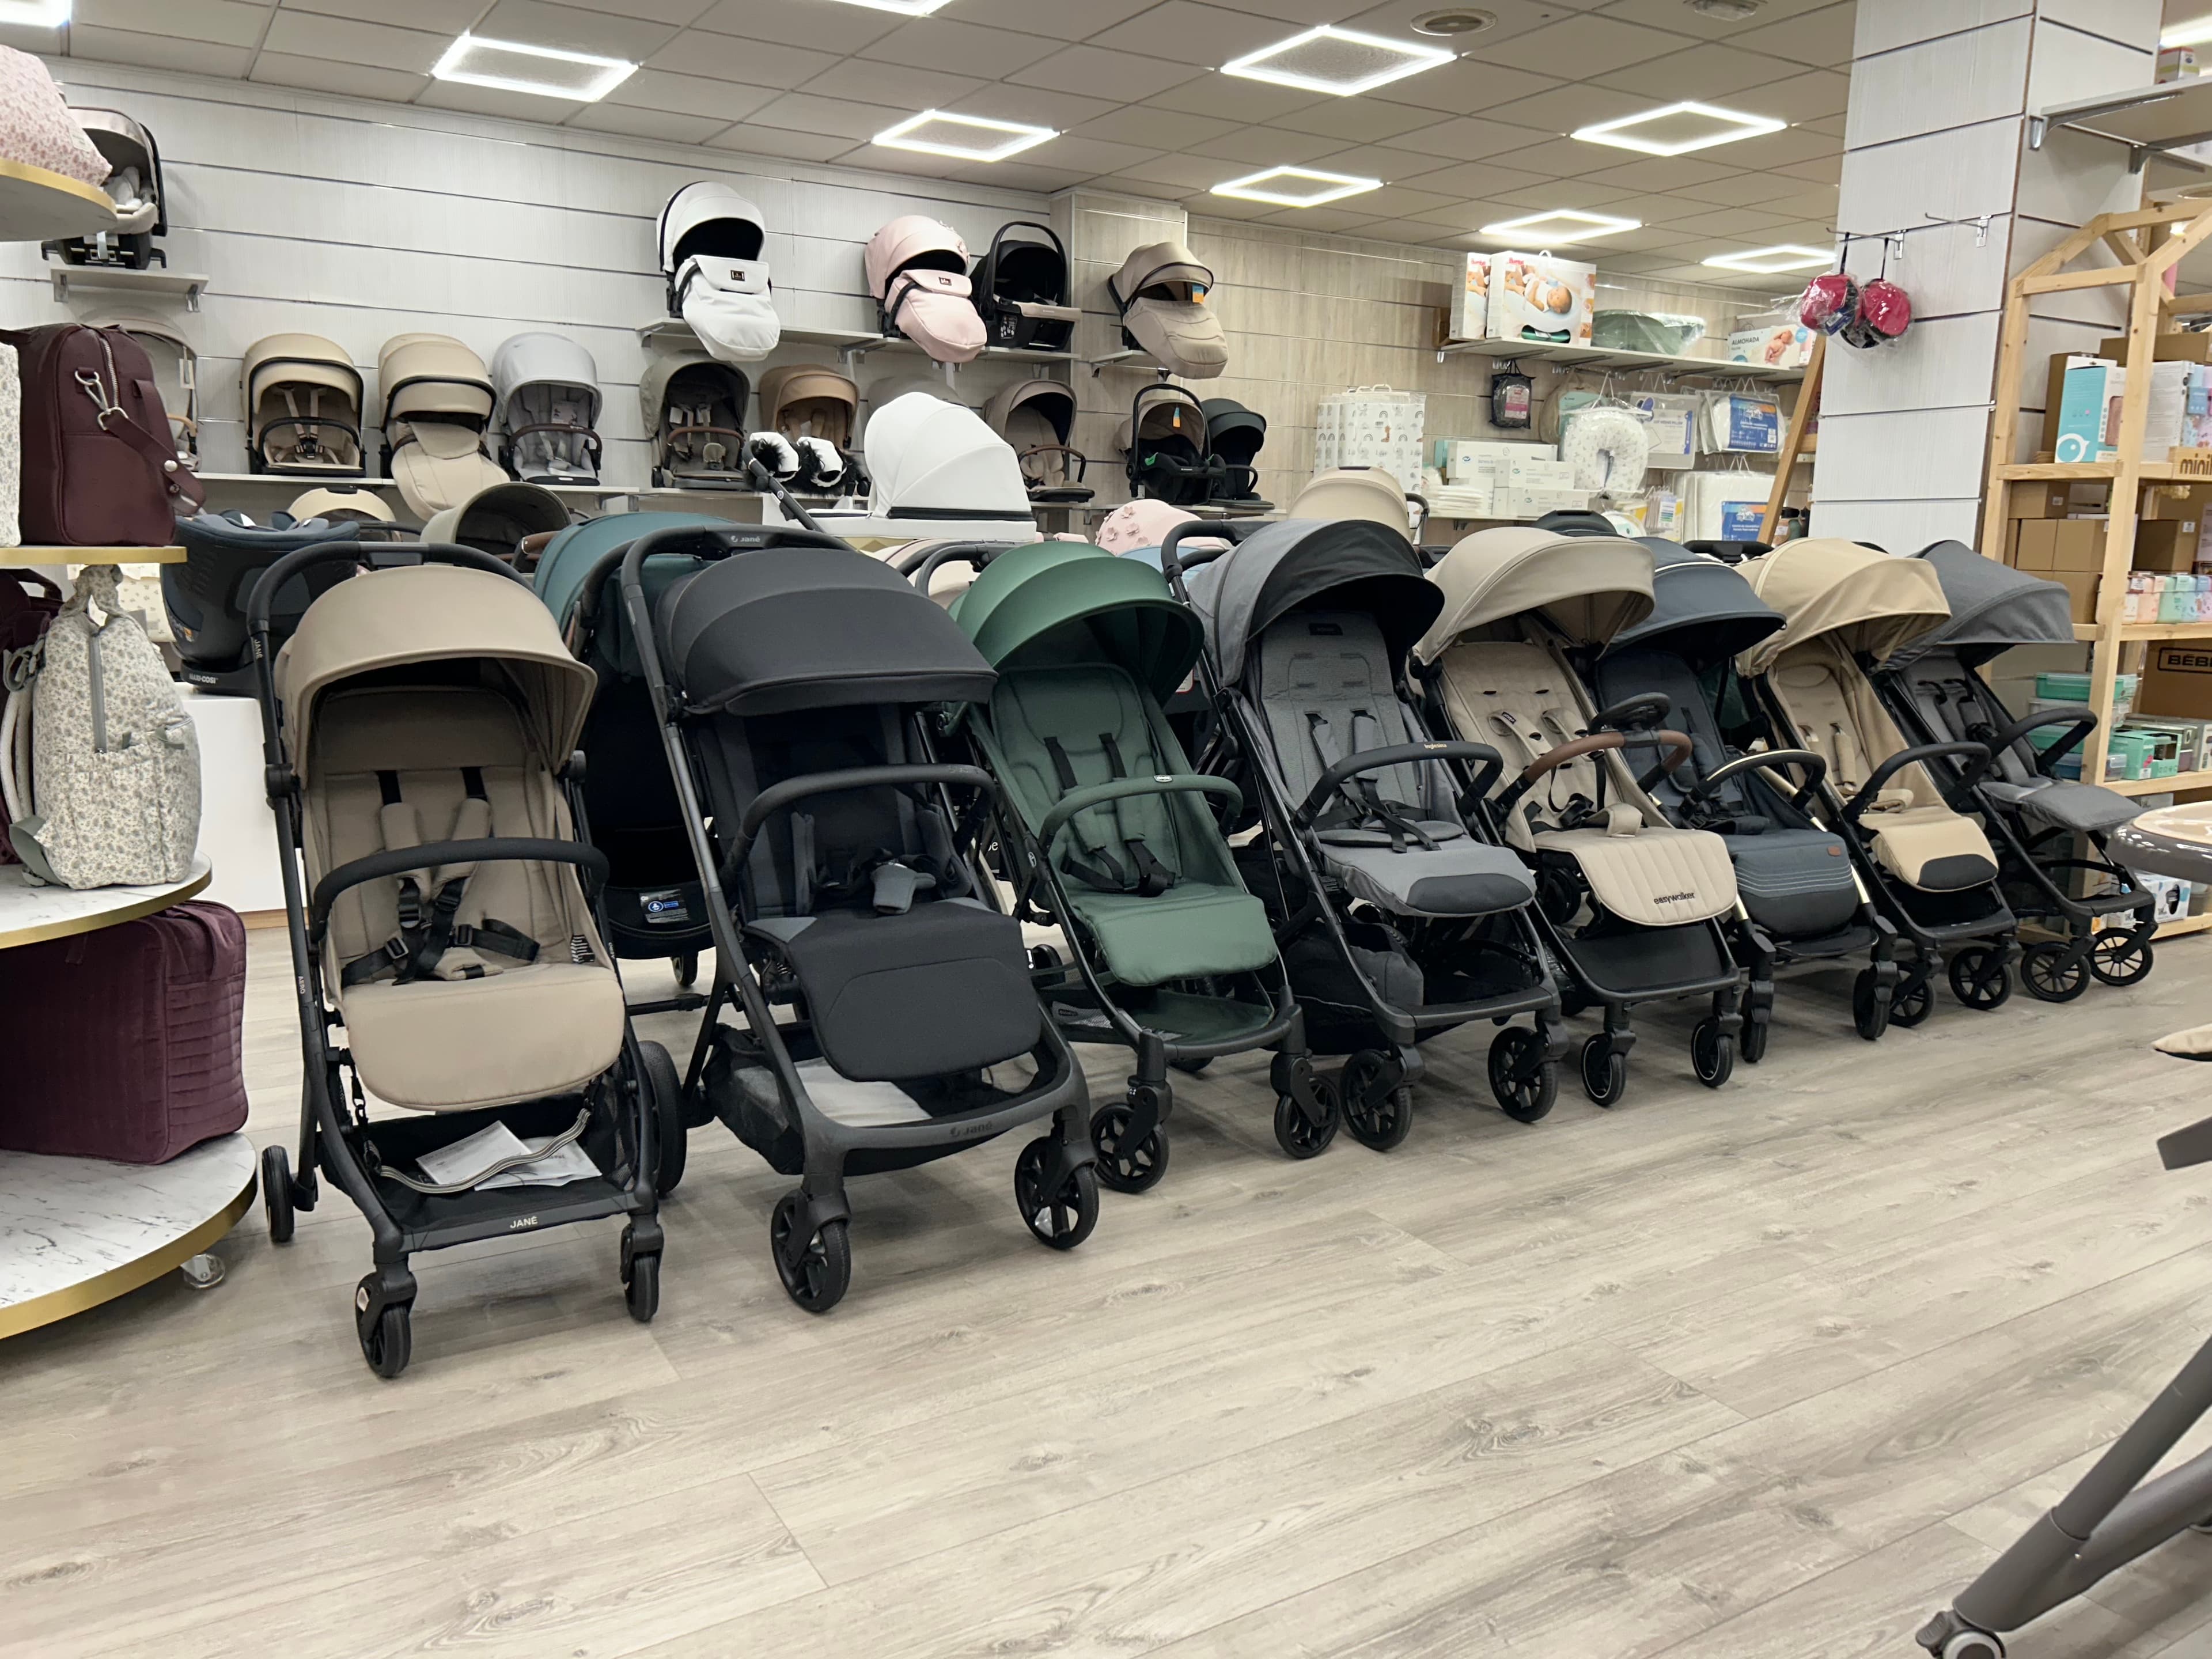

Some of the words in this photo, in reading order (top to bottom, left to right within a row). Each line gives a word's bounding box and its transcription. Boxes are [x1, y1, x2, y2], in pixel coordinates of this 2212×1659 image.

[1732, 336, 1760, 346] ALMOHADA
[2168, 654, 2212, 666] BÉB
[1654, 892, 1695, 904] easywalker
[510, 1216, 538, 1229] JANÉ
